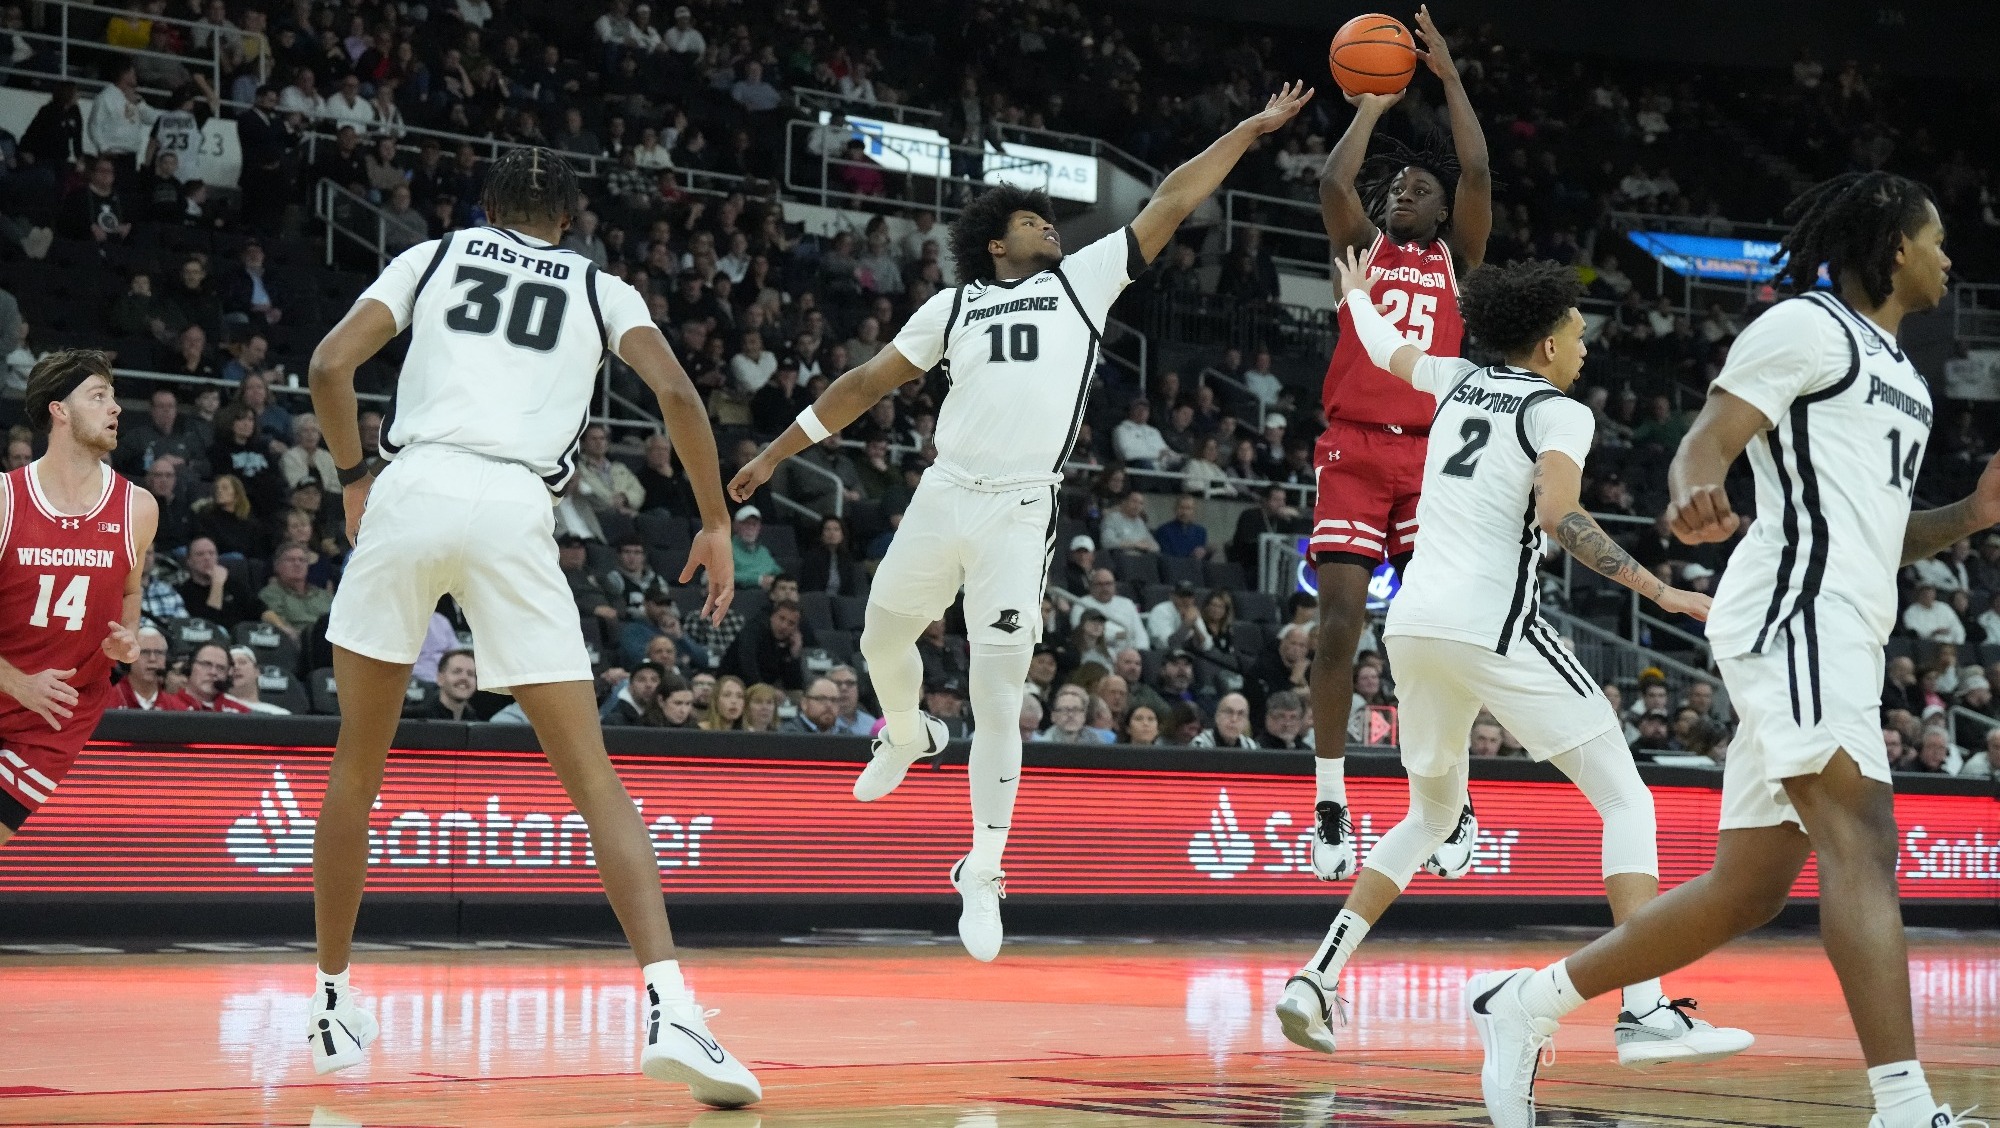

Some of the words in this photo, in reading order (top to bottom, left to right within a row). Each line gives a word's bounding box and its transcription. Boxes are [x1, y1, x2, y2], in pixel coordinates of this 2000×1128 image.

[166, 133, 189, 150] 23
[465, 240, 570, 280] CASTRO
[444, 263, 570, 354] 30
[962, 296, 1059, 328] PROVIDENCE
[1381, 289, 1437, 351] 25
[981, 323, 1039, 364] 10
[1864, 371, 1934, 431] PROVIDENC
[1440, 416, 1492, 480] 2
[1883, 425, 1921, 498] 14
[17, 547, 115, 568] WISCONSIN
[29, 574, 91, 631] 14
[368, 795, 713, 867] antaner
